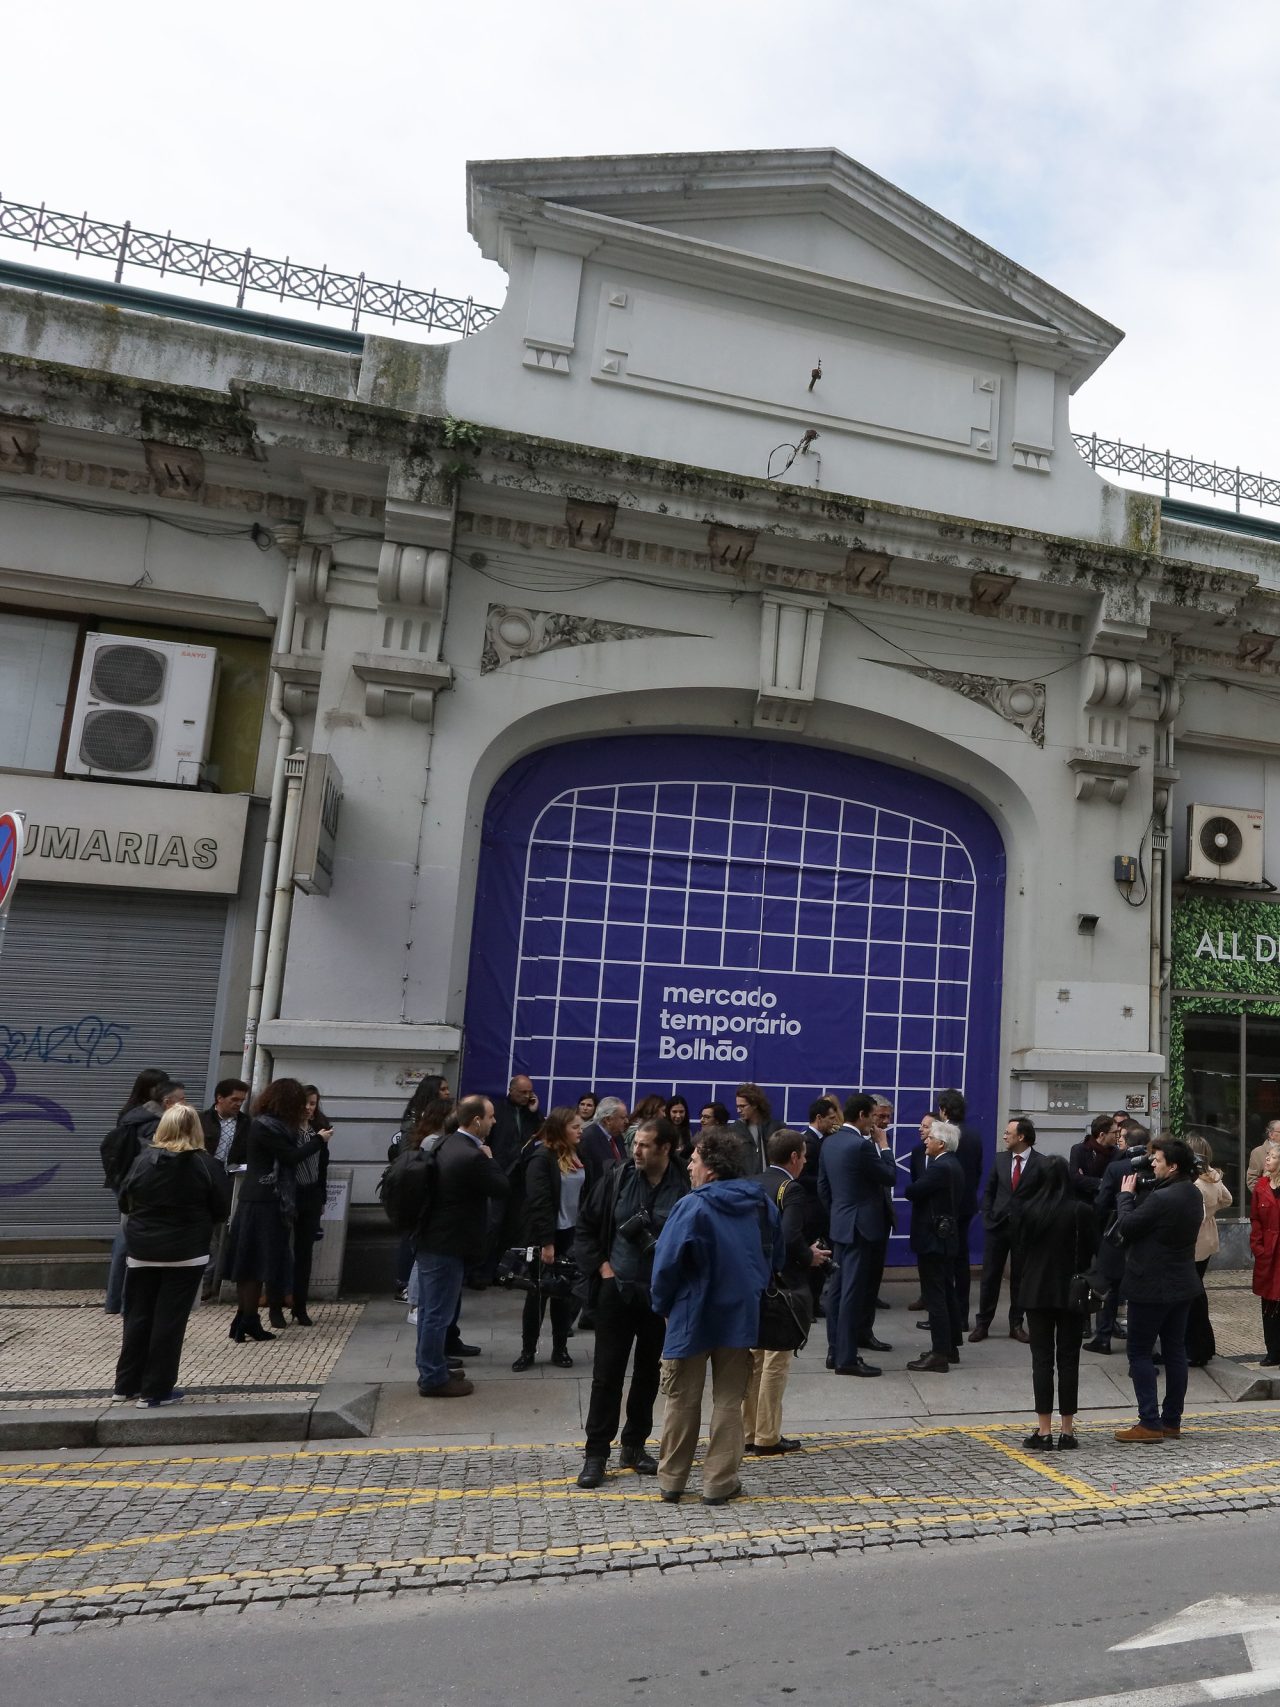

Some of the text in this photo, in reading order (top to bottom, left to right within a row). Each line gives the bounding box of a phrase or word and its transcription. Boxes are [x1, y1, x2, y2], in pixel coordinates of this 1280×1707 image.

[1195, 930, 1246, 961] ALL
[663, 986, 777, 1008] mercado
[659, 1009, 802, 1036] temporário
